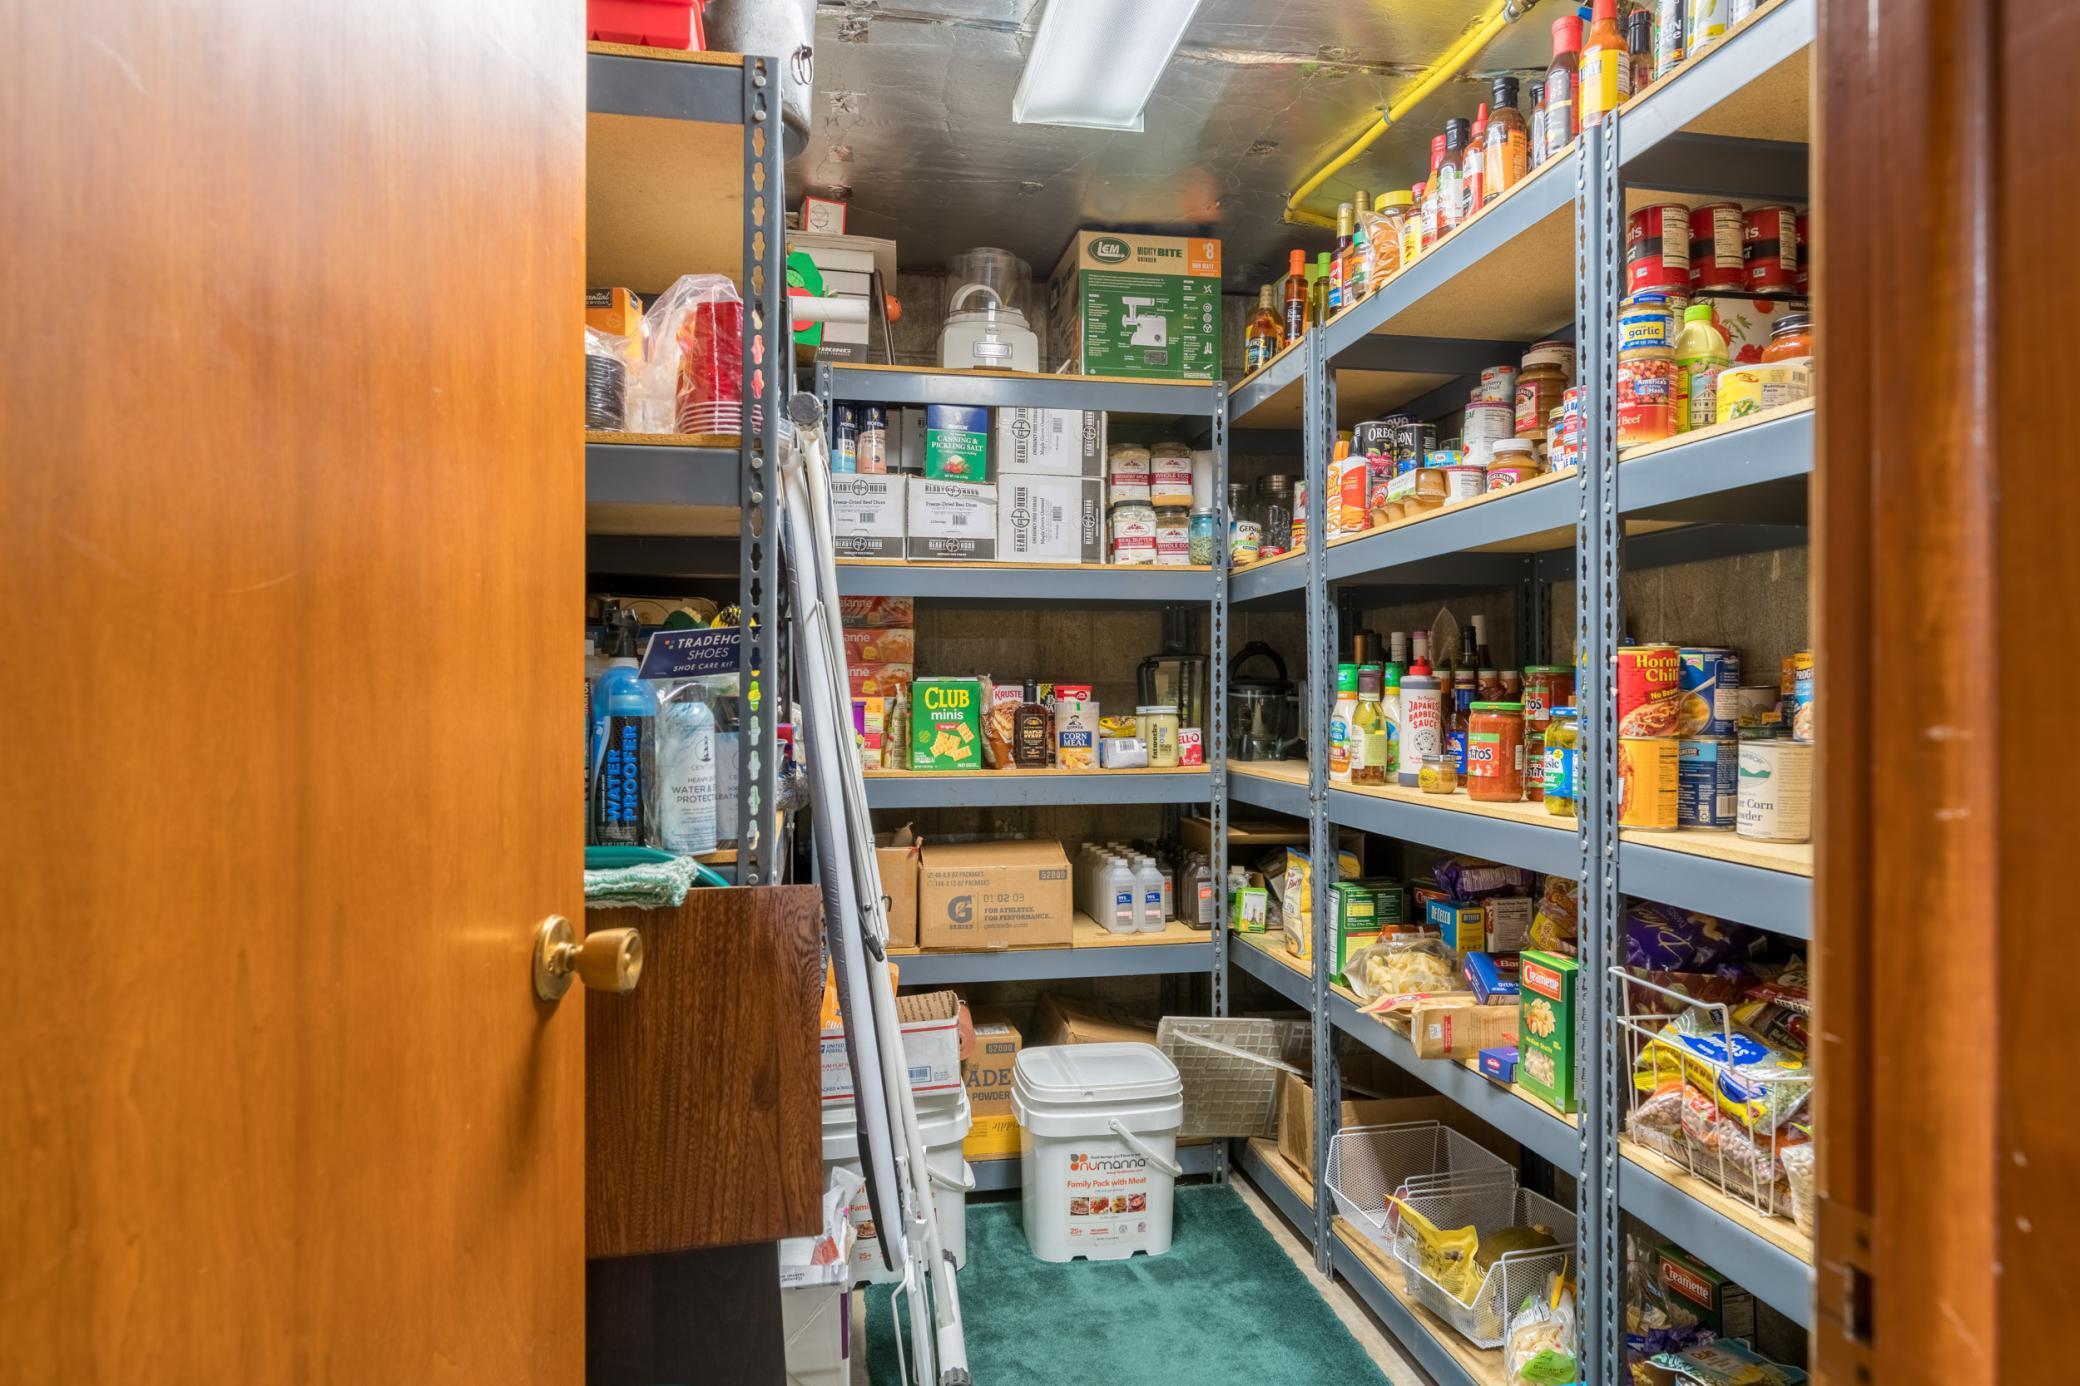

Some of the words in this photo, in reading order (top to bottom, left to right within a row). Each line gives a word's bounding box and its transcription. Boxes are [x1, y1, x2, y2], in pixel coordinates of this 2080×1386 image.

[1097, 241, 1125, 257] LEM
[1158, 248, 1182, 258] BITE
[1628, 327, 1660, 338] garlic
[1622, 414, 1642, 425] Beef
[937, 434, 971, 445] CANNING
[931, 441, 966, 451] PICKLING
[966, 444, 984, 452] SALT
[688, 647, 729, 660] SHOES
[673, 664, 697, 672] SHOE
[698, 662, 719, 671] CARE
[721, 661, 734, 669] KIT
[925, 687, 970, 709] CLUB
[931, 709, 964, 721] minis
[1413, 719, 1438, 730] SAUCE
[1063, 732, 1088, 740] CORN
[622, 726, 638, 822] PROOFER
[608, 750, 621, 822] WATER
[672, 786, 706, 794] WATER
[1747, 798, 1774, 810] Corn
[997, 894, 1011, 902] 02
[1013, 893, 1025, 902] 03
[1524, 965, 1560, 991] Creamette
[965, 1067, 1012, 1088] ADE
[971, 1091, 1010, 1102] POWDER
[1080, 1159, 1146, 1171] numanna
[1067, 1180, 1092, 1189] Family
[1093, 1179, 1110, 1187] Pack
[1111, 1178, 1127, 1186] with
[1128, 1176, 1147, 1184] Meat
[1662, 1263, 1710, 1300] Creamette
